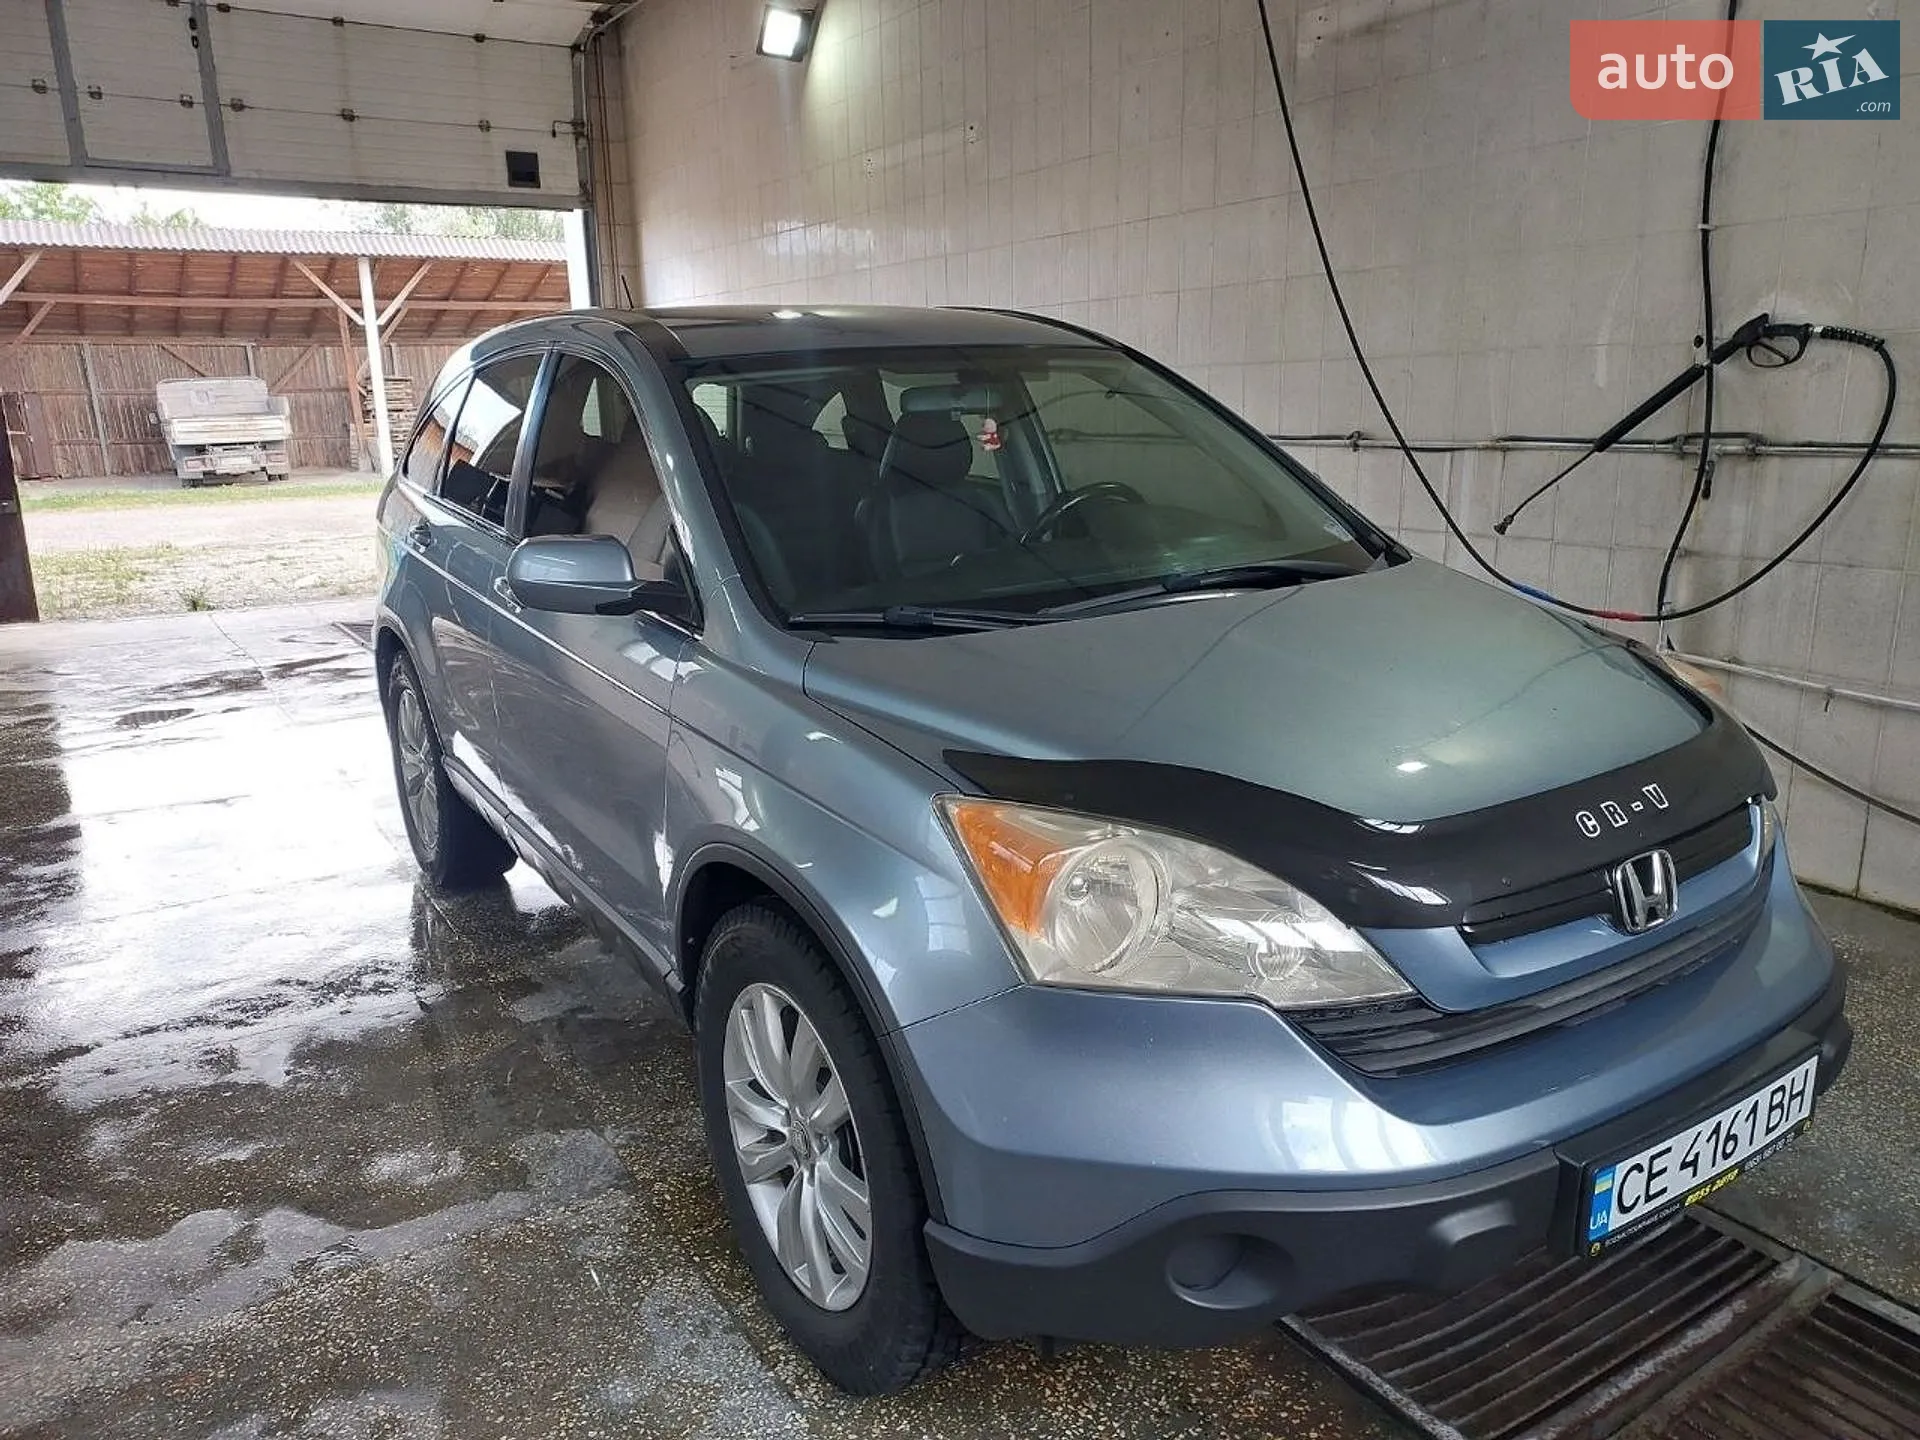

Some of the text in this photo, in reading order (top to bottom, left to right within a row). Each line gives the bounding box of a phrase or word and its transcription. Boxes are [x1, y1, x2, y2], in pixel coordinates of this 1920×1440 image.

[1575, 783, 1669, 837] CR-V
[1616, 1146, 1672, 1215] CE
[1678, 1099, 1760, 1179] 4161
[1764, 1068, 1810, 1137] BH
[1590, 1210, 1608, 1230] UA
